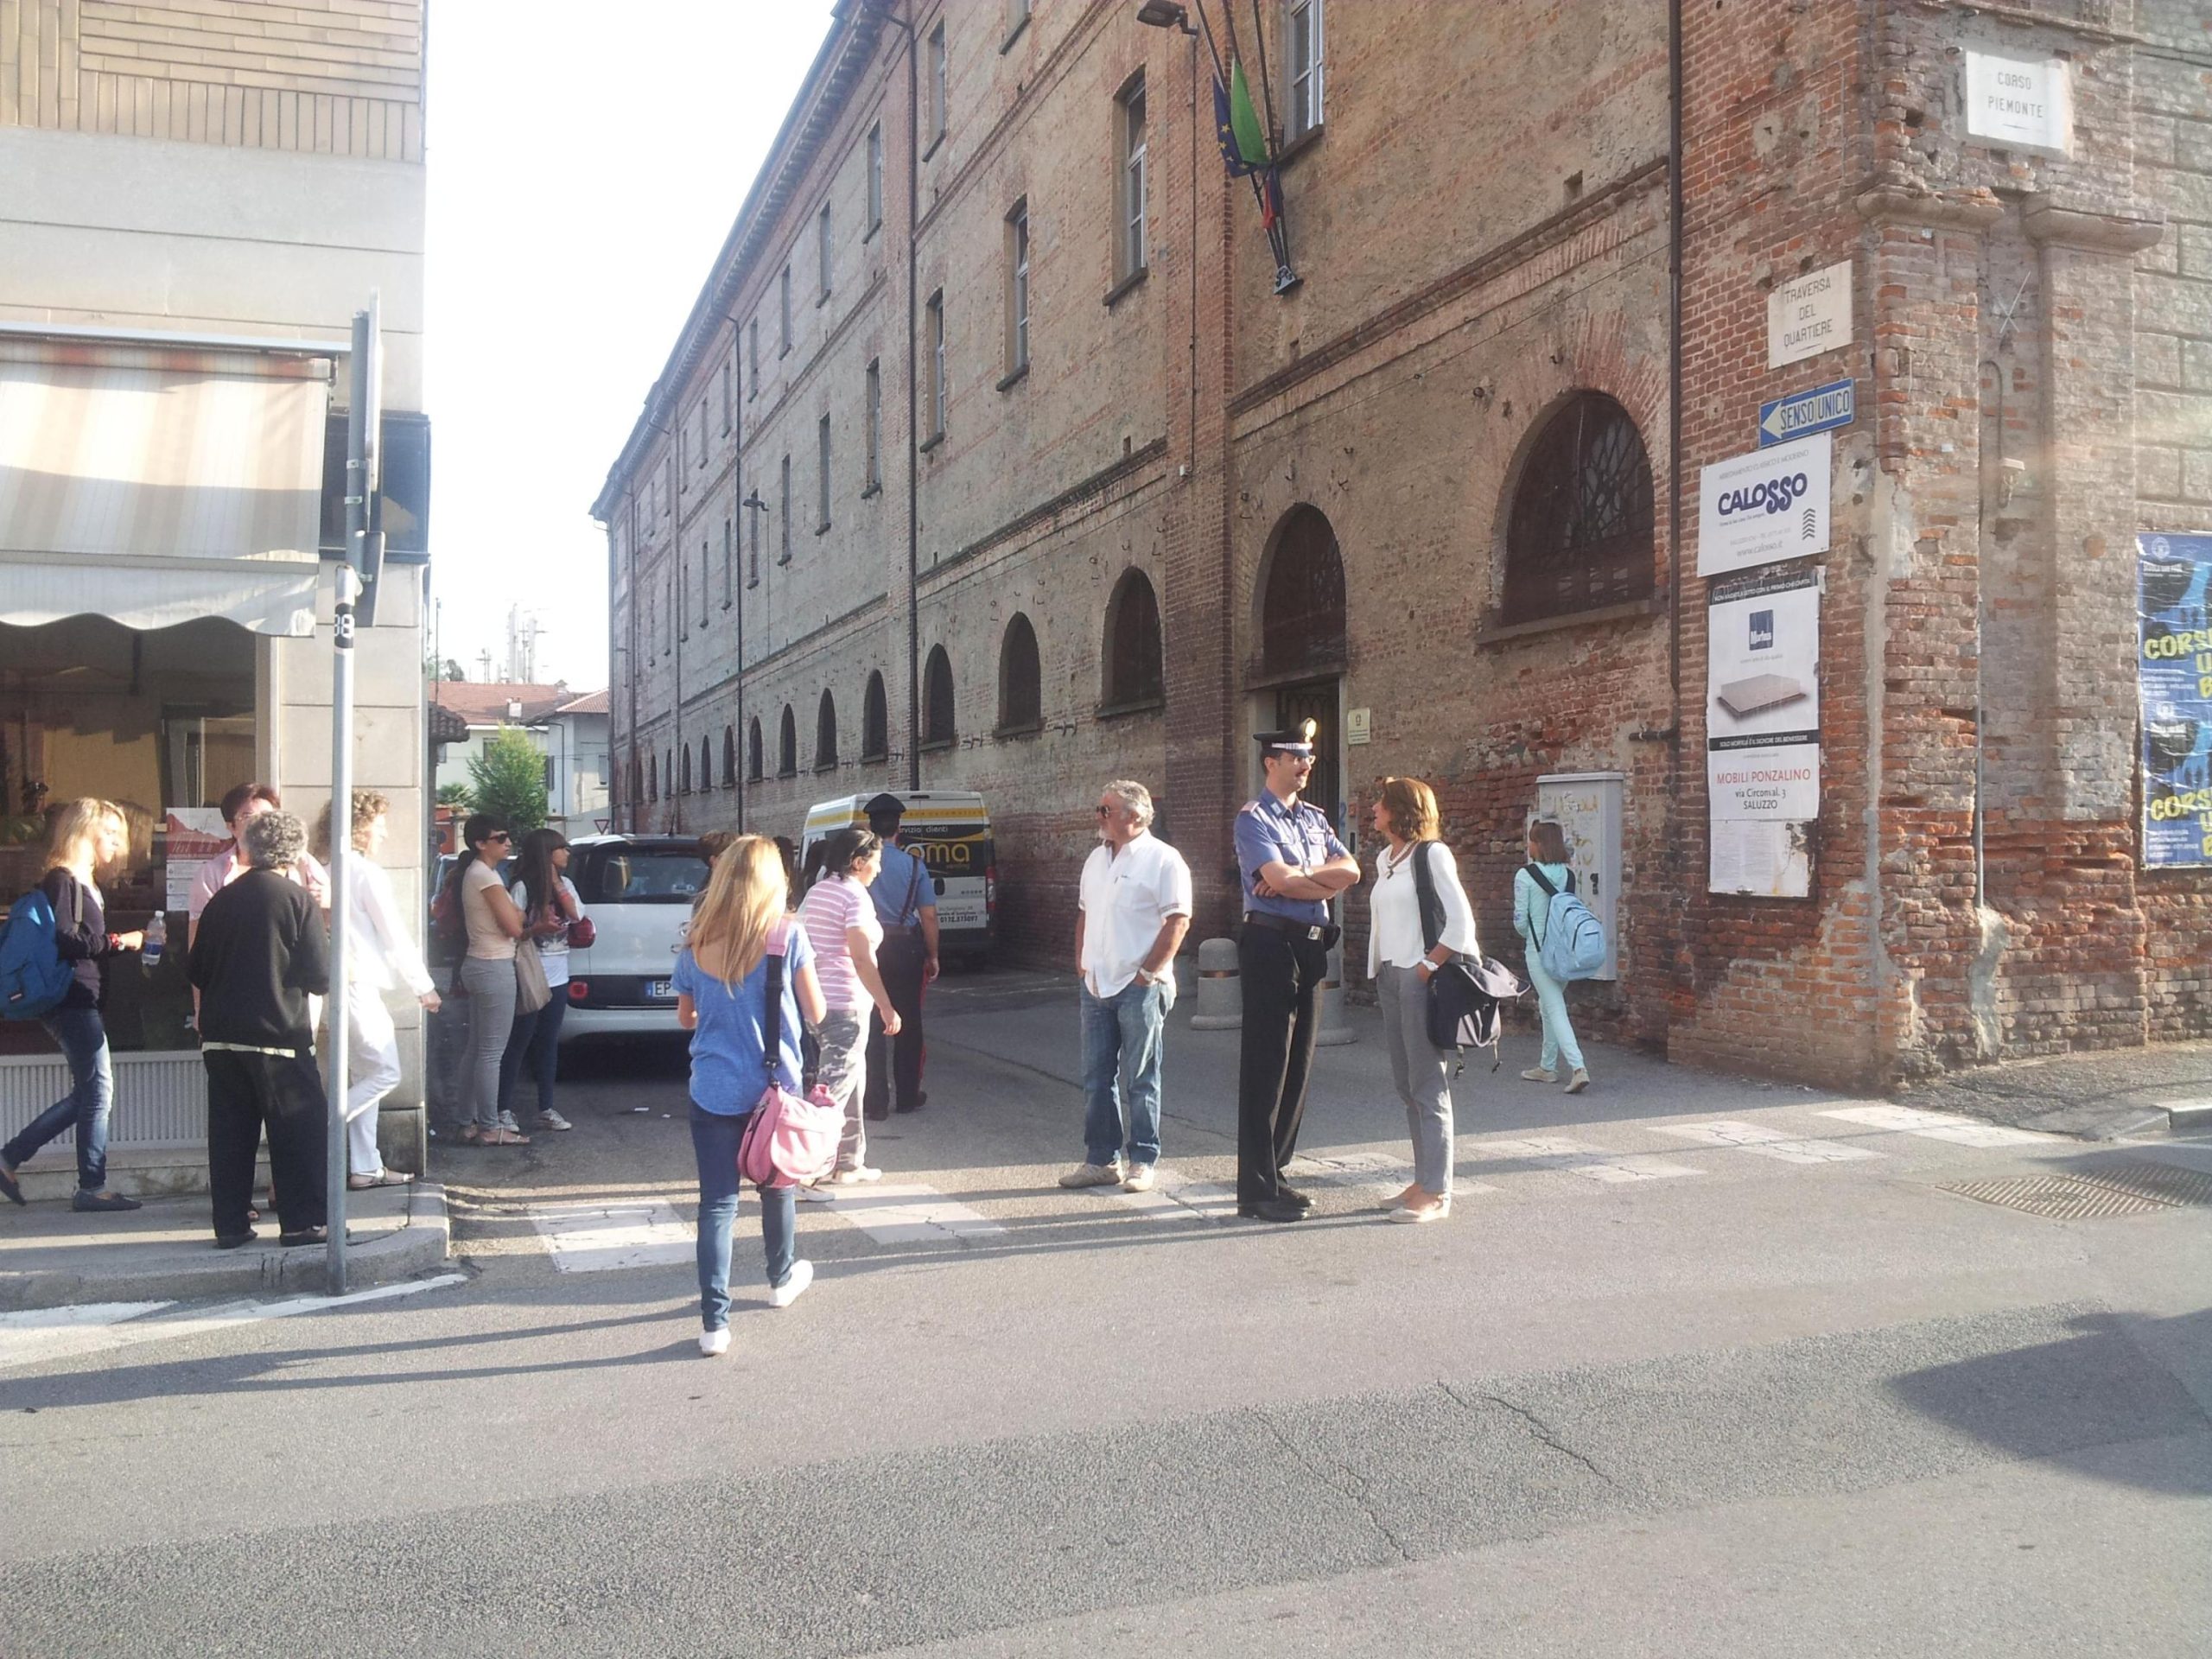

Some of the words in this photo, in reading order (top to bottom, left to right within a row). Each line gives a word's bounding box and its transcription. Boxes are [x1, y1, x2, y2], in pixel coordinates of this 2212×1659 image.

[1998, 72, 2031, 90] CORSO
[1988, 96, 2043, 118] PIEMONTE
[1784, 276, 1831, 304] TRAVERSA
[1799, 304, 1816, 321] DEL
[1783, 319, 1833, 349] QUARTIERE
[1781, 401, 1815, 430] SENSO
[1818, 390, 1850, 419] UNICO
[1718, 473, 1808, 515] CALOSSO
[1717, 772, 1749, 785] MOBILI
[1751, 768, 1811, 783] PONZALINO
[1735, 788, 1745, 798] via
[1743, 799, 1778, 810] SALUZZO
